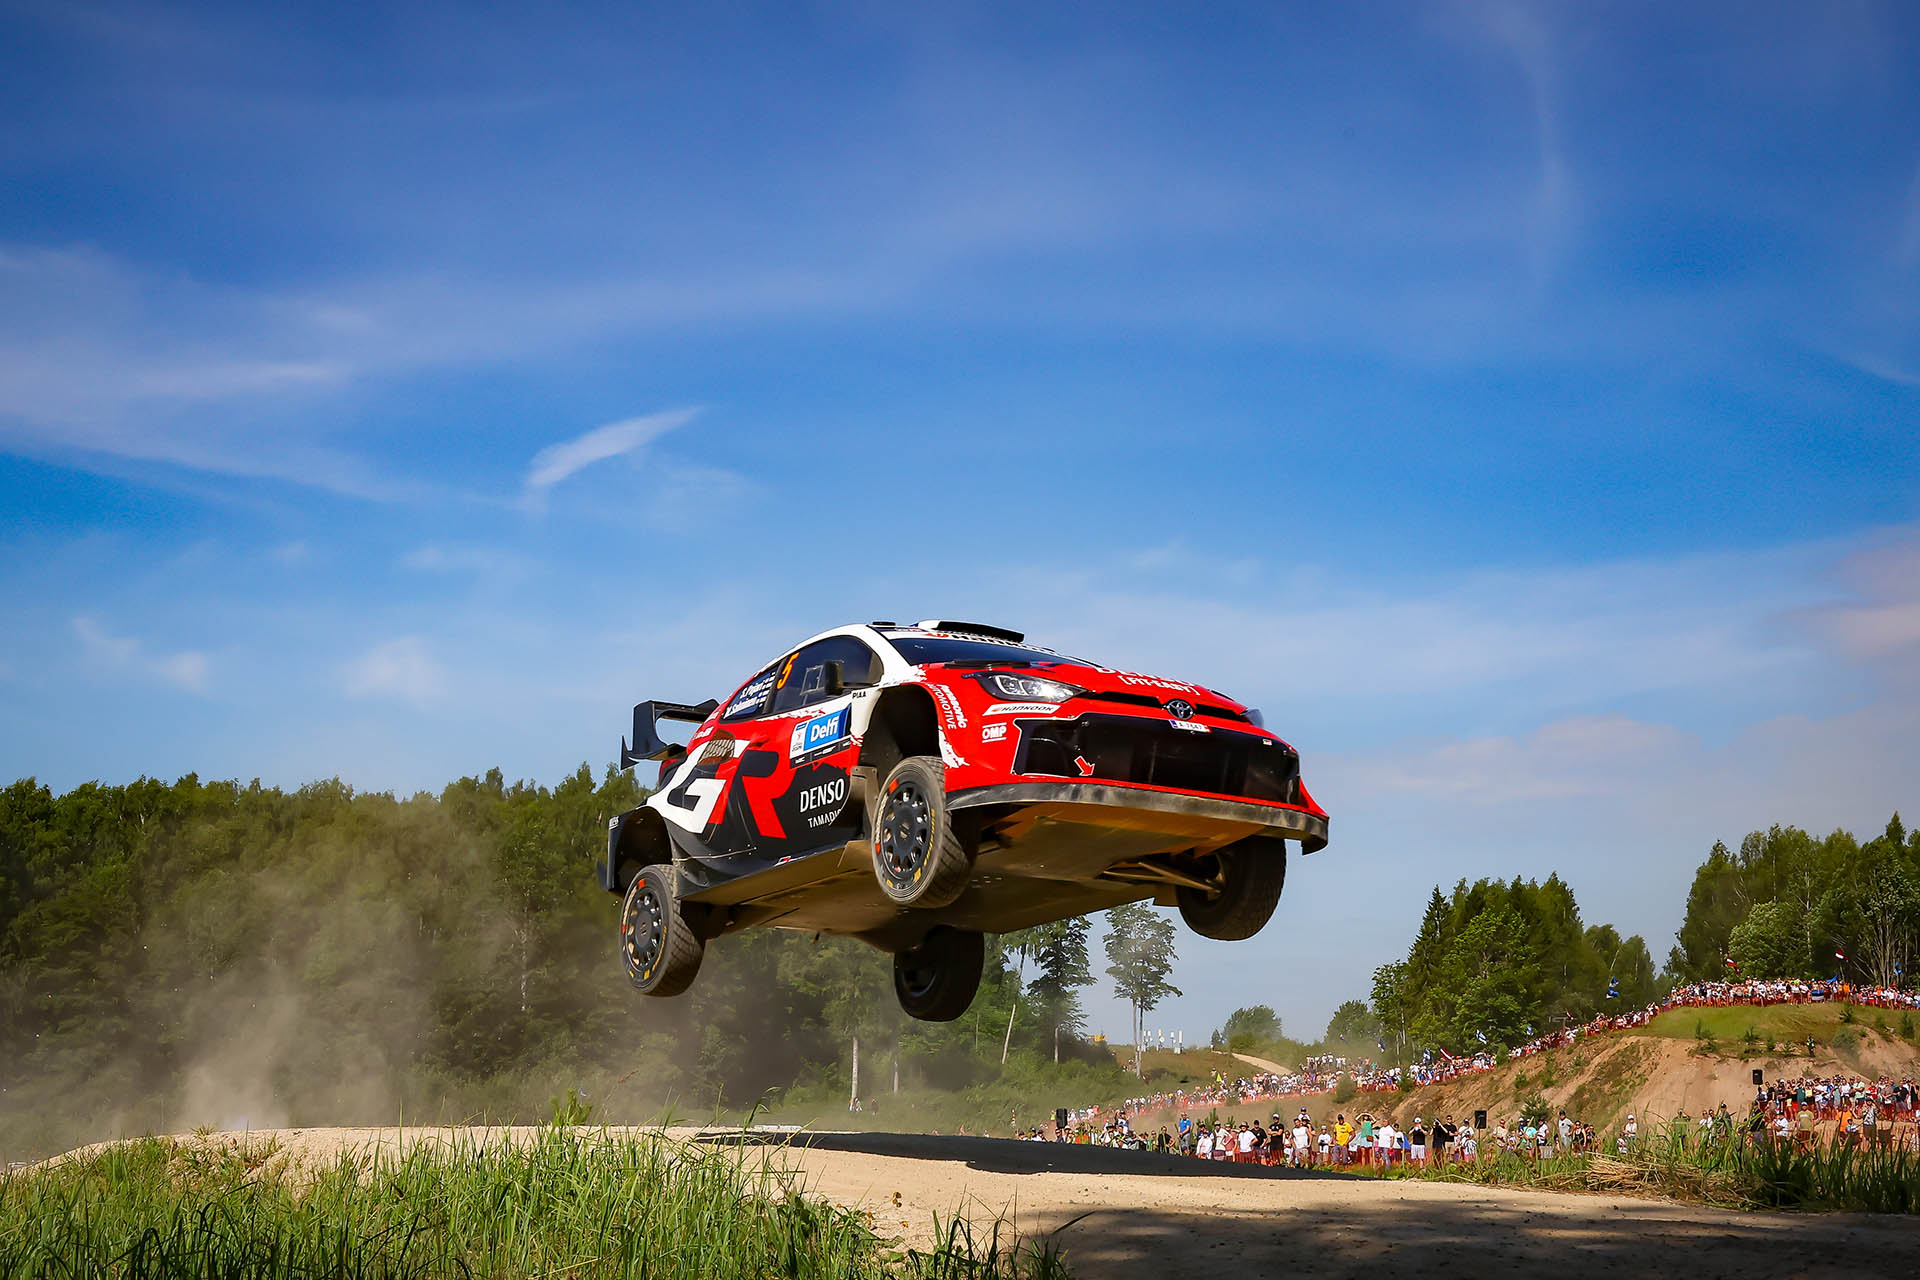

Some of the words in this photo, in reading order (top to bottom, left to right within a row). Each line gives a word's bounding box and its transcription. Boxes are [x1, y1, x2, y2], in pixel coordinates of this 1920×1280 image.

[776, 652, 799, 690] 5
[852, 691, 867, 699] PIAA
[810, 715, 840, 743] Delfi
[982, 726, 1007, 739] OMP
[800, 778, 845, 813] DENSO
